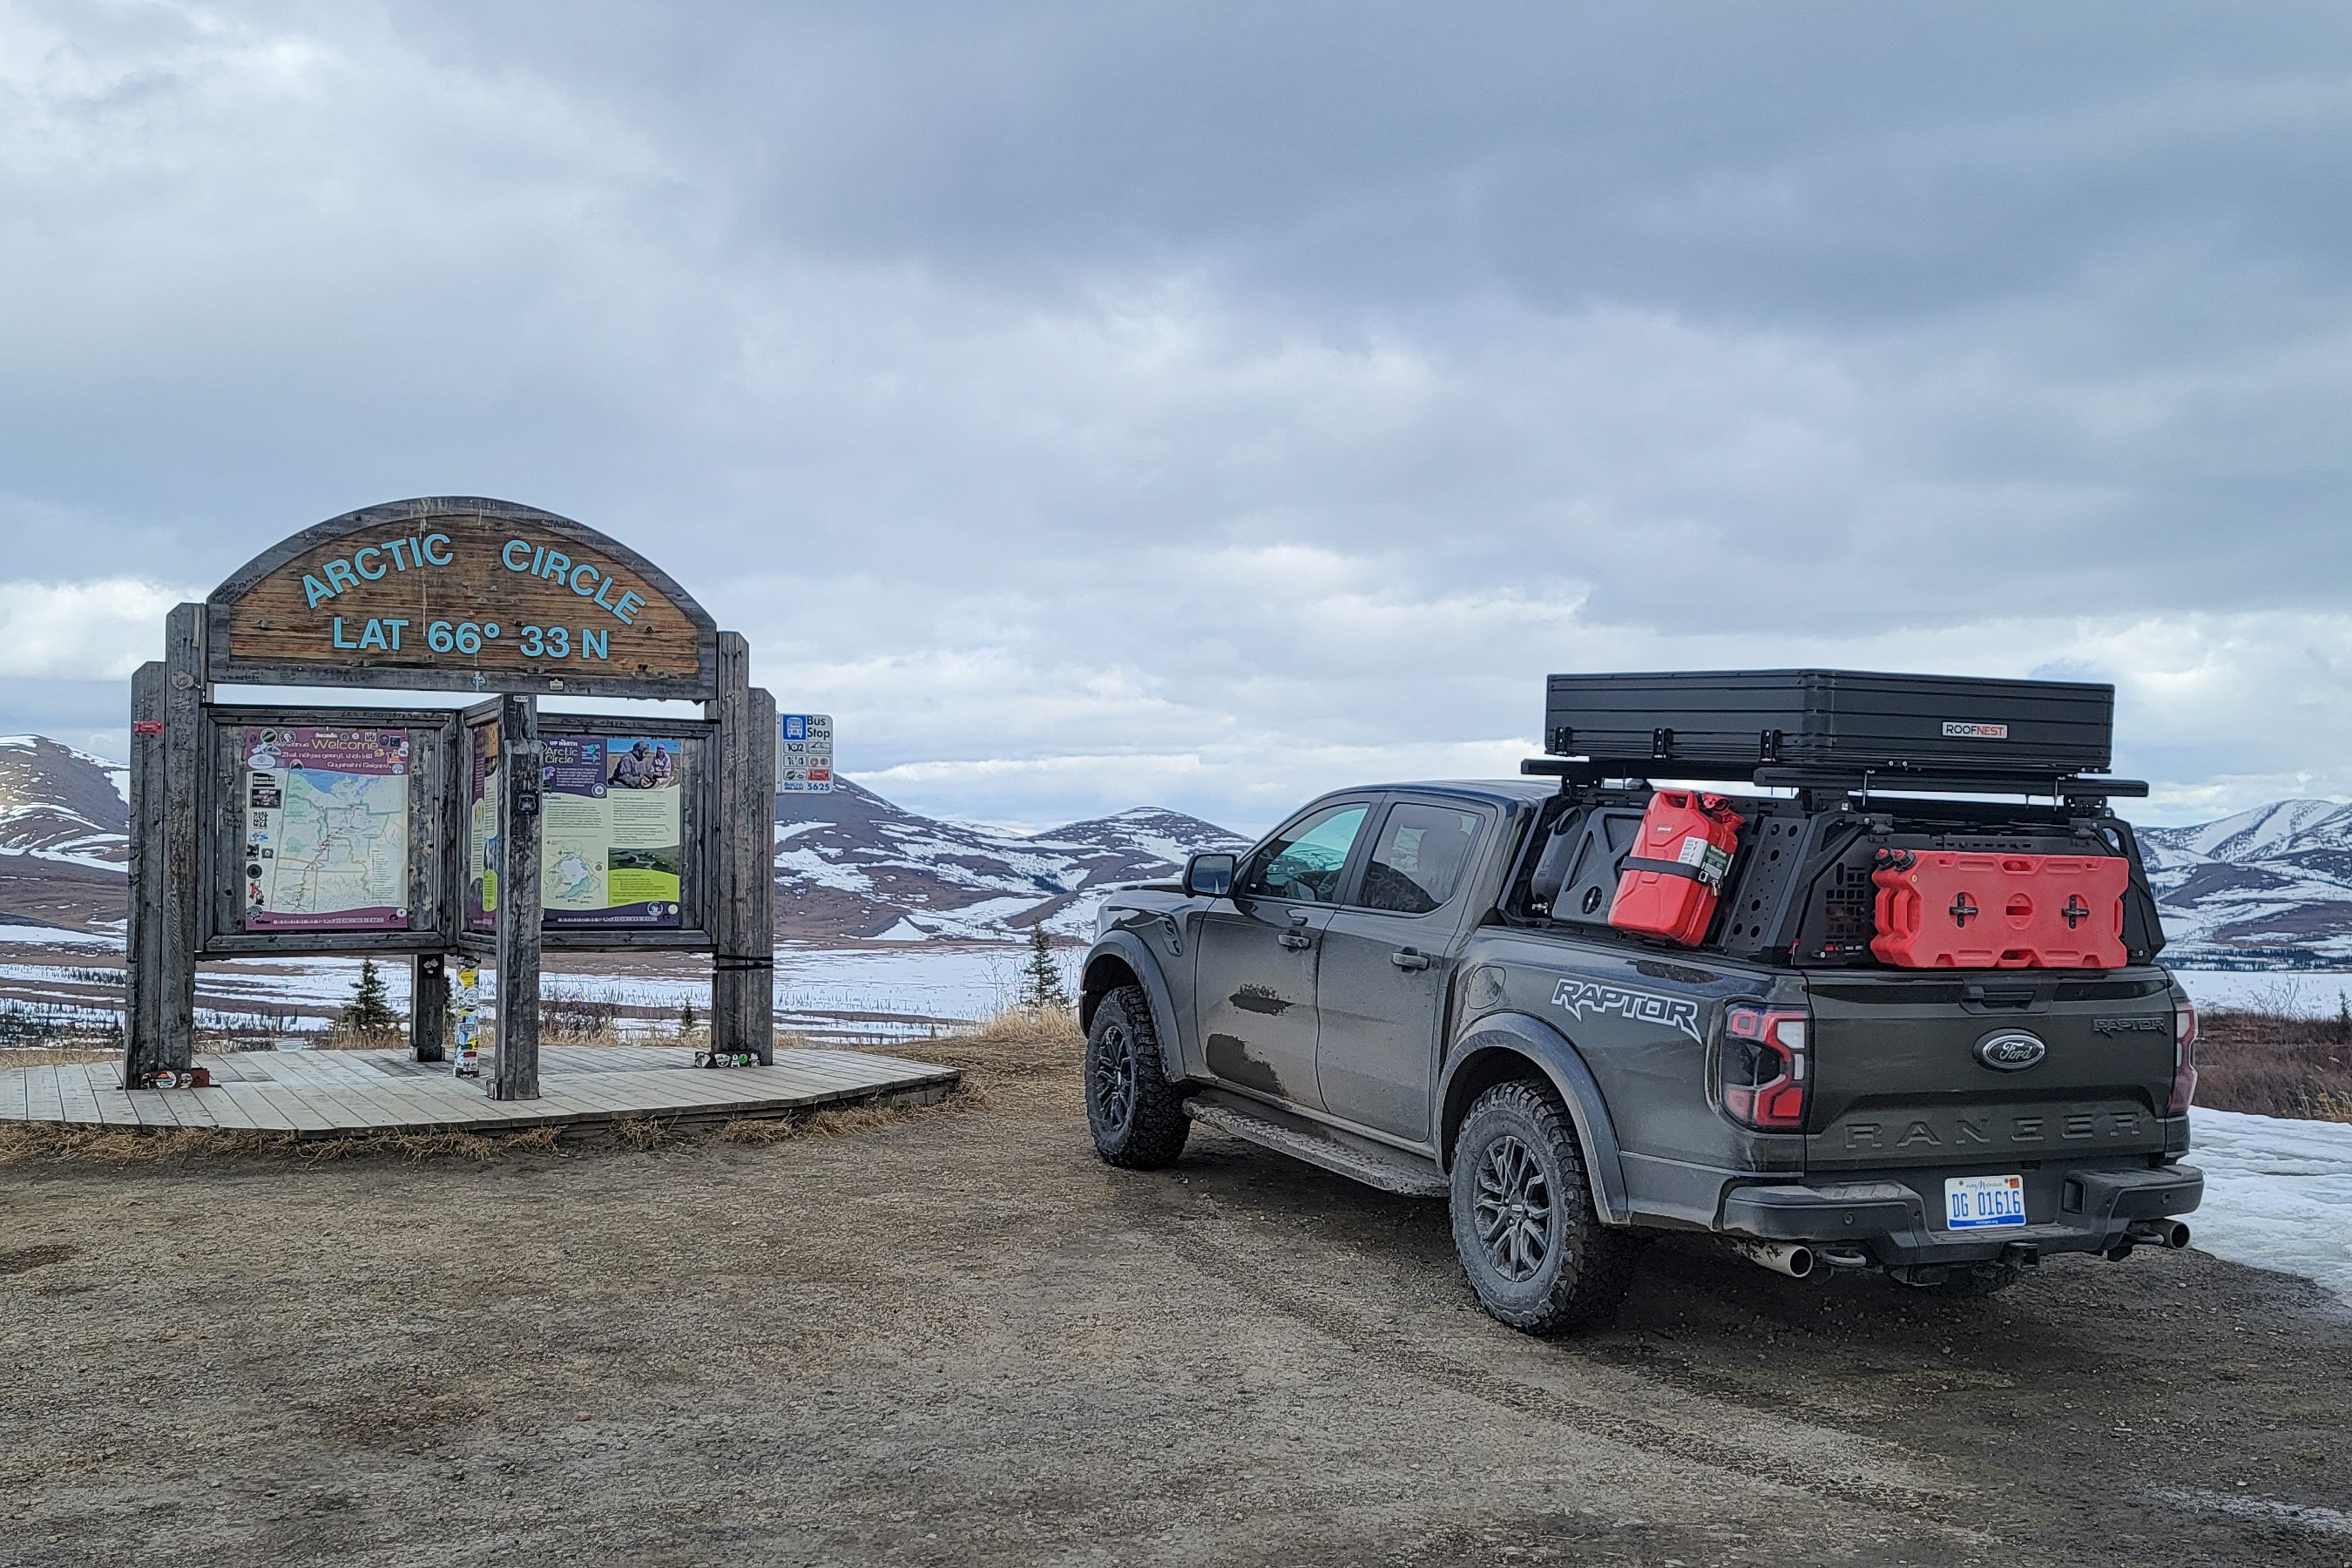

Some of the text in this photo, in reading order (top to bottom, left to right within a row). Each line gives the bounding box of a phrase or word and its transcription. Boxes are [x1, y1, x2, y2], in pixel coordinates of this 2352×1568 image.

[302, 533, 646, 625] ARCTIC CIRCLE
[334, 617, 608, 659] LAT 66° 33 N
[807, 716, 826, 726] Bus
[1946, 724, 2004, 735] ROOFNEST
[807, 727, 830, 740] Stop
[311, 738, 379, 751] Welcome
[545, 747, 578, 756] Arctic
[545, 754, 573, 763] Circle
[1551, 978, 1702, 1045] RAPTOR
[2093, 1017, 2168, 1038] RAPTOR
[2000, 1042, 2033, 1059] Ford
[1845, 1112, 2140, 1149] RANGER
[1952, 1190, 2021, 1218] DG 01616
